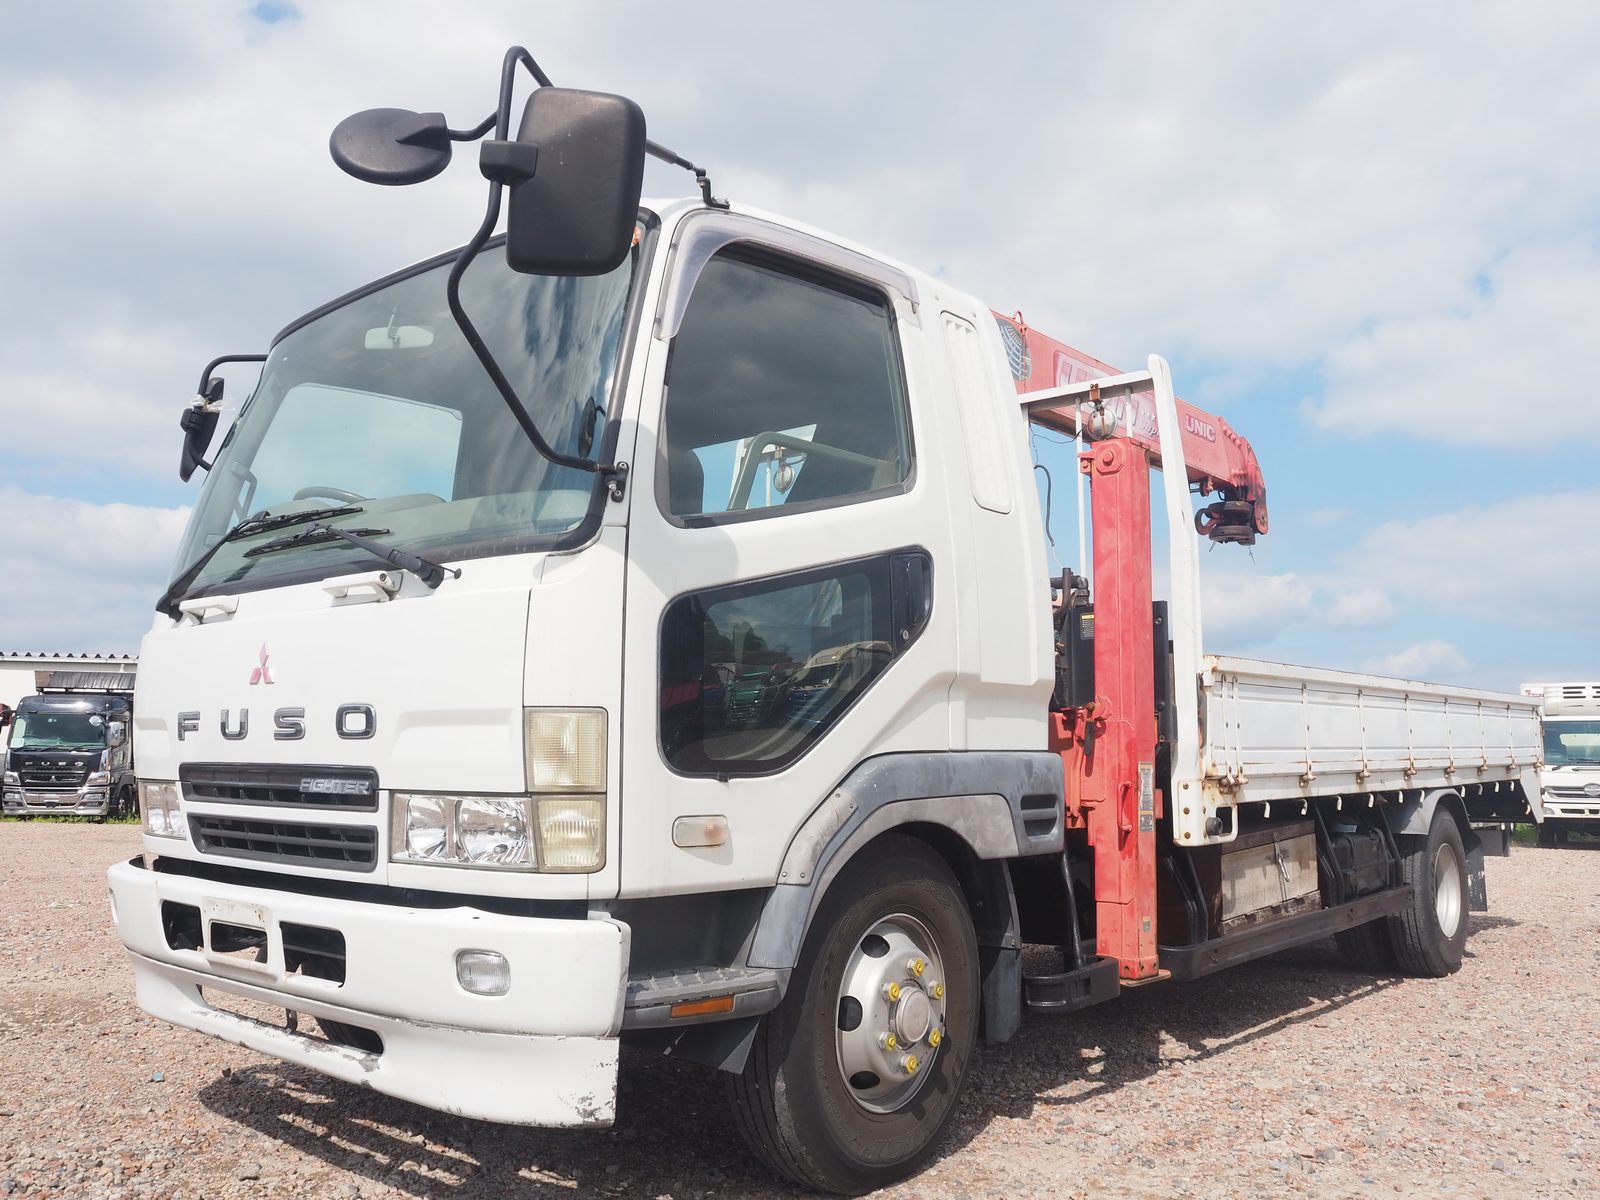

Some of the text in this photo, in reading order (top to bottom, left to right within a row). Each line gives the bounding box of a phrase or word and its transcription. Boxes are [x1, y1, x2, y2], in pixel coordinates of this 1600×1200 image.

[1185, 413, 1216, 443] UNIC
[177, 703, 377, 741] FUSO
[299, 777, 372, 795] FIGHTER
